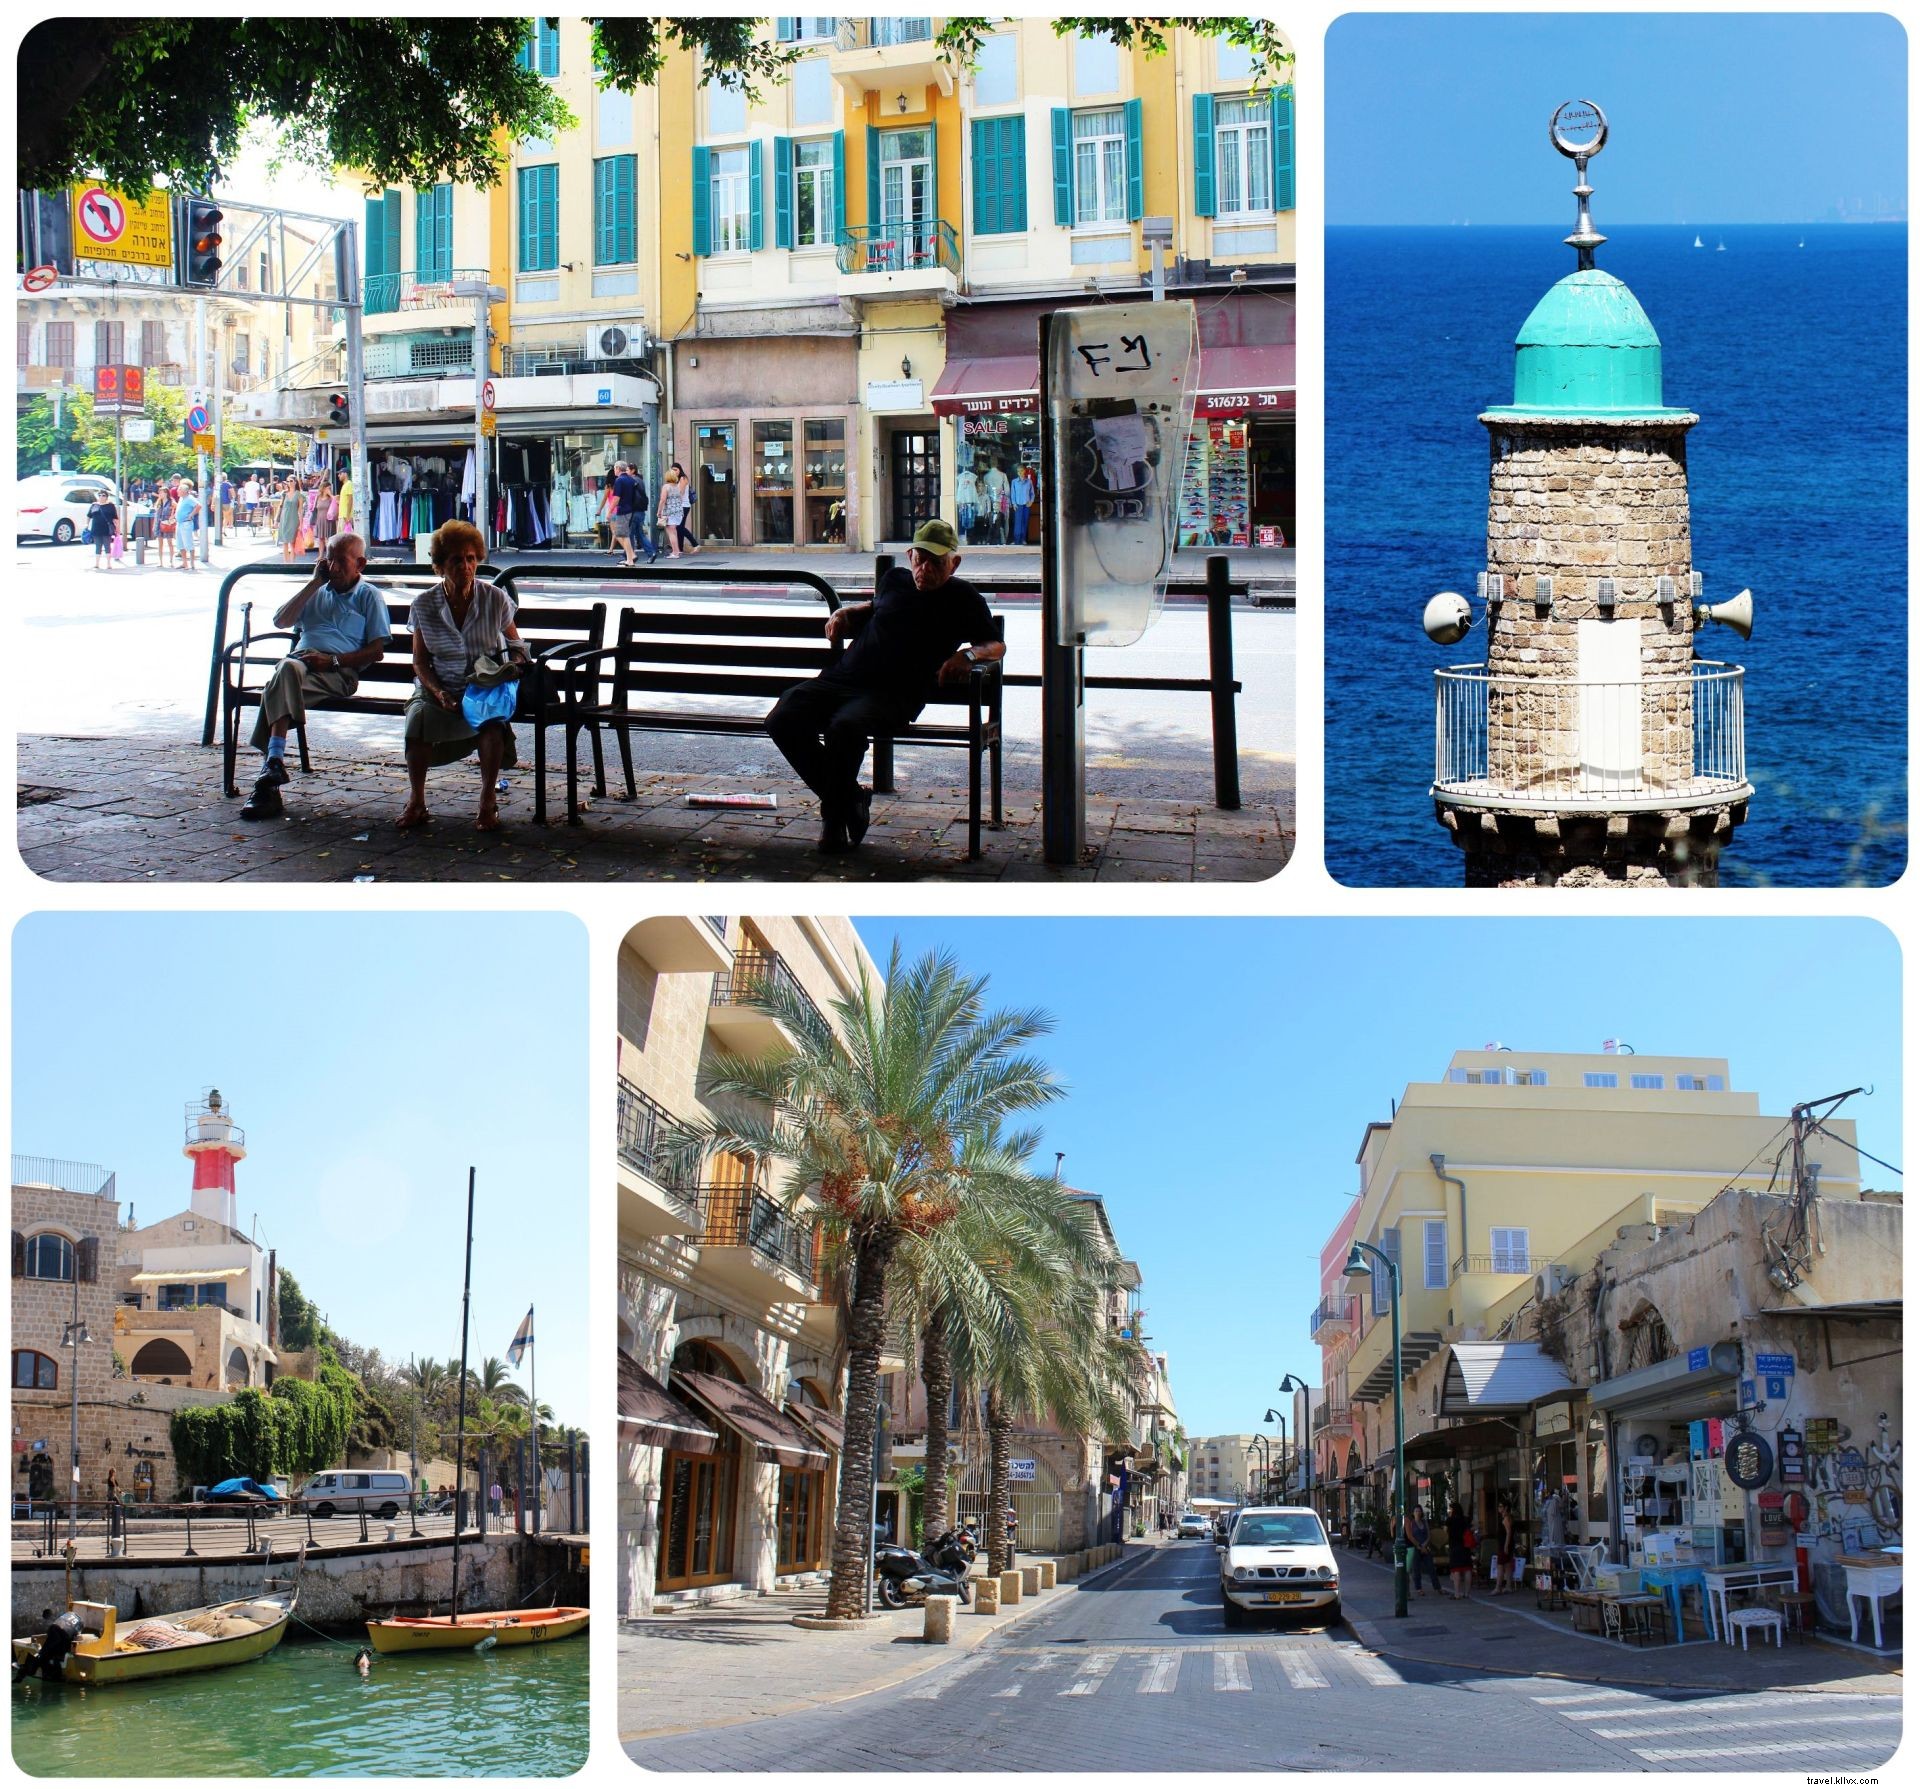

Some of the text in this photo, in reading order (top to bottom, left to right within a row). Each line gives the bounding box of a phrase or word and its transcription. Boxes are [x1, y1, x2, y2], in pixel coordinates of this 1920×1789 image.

[132, 234, 166, 249] אסורה
[83, 245, 166, 262] סע בדרכים חלופיות
[599, 391, 610, 401] 60
[1207, 395, 1250, 408] 5176732
[961, 397, 1034, 412] ילדים ונוער
[963, 420, 1008, 434] SALE
[1772, 1381, 1780, 1395] 9
[1764, 1513, 1783, 1522] LOVE
